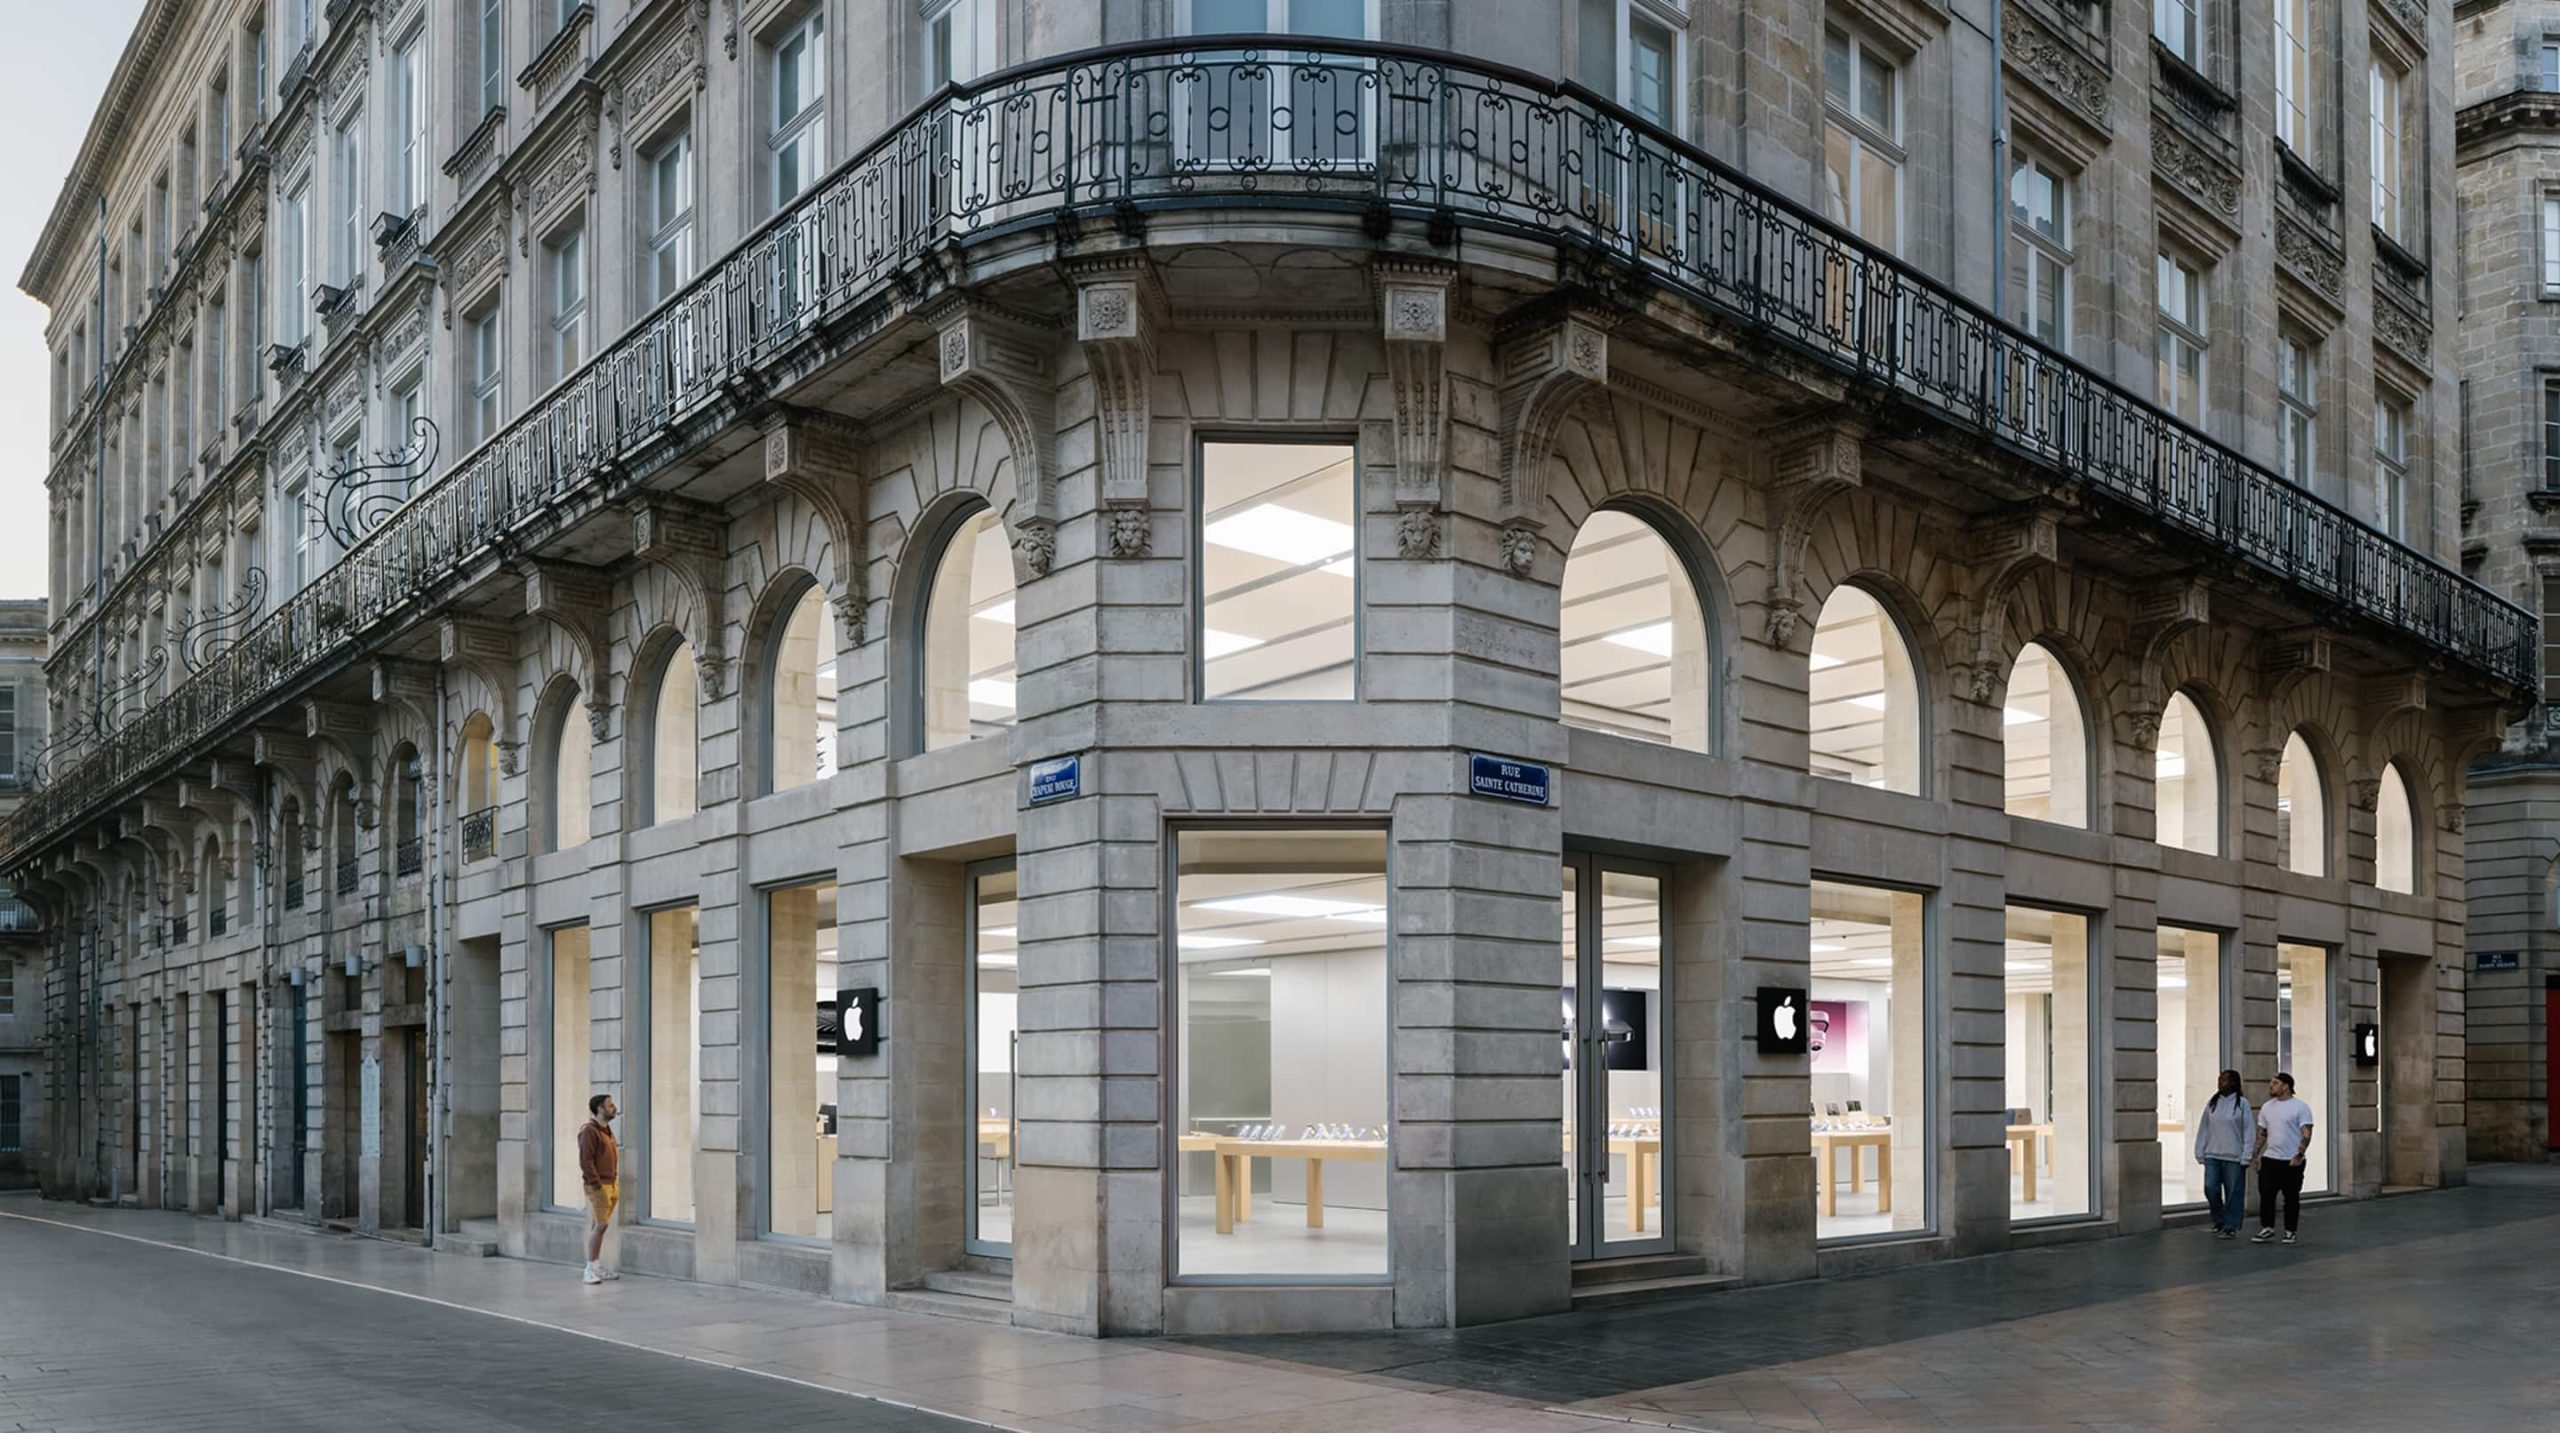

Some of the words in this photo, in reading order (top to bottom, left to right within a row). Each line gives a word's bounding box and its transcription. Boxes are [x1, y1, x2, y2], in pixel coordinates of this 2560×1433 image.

[1501, 764, 1521, 778] RUE
[1045, 775, 1057, 783] DU
[1475, 776, 1503, 790] SAINTE
[1505, 781, 1544, 797] CATHERINE
